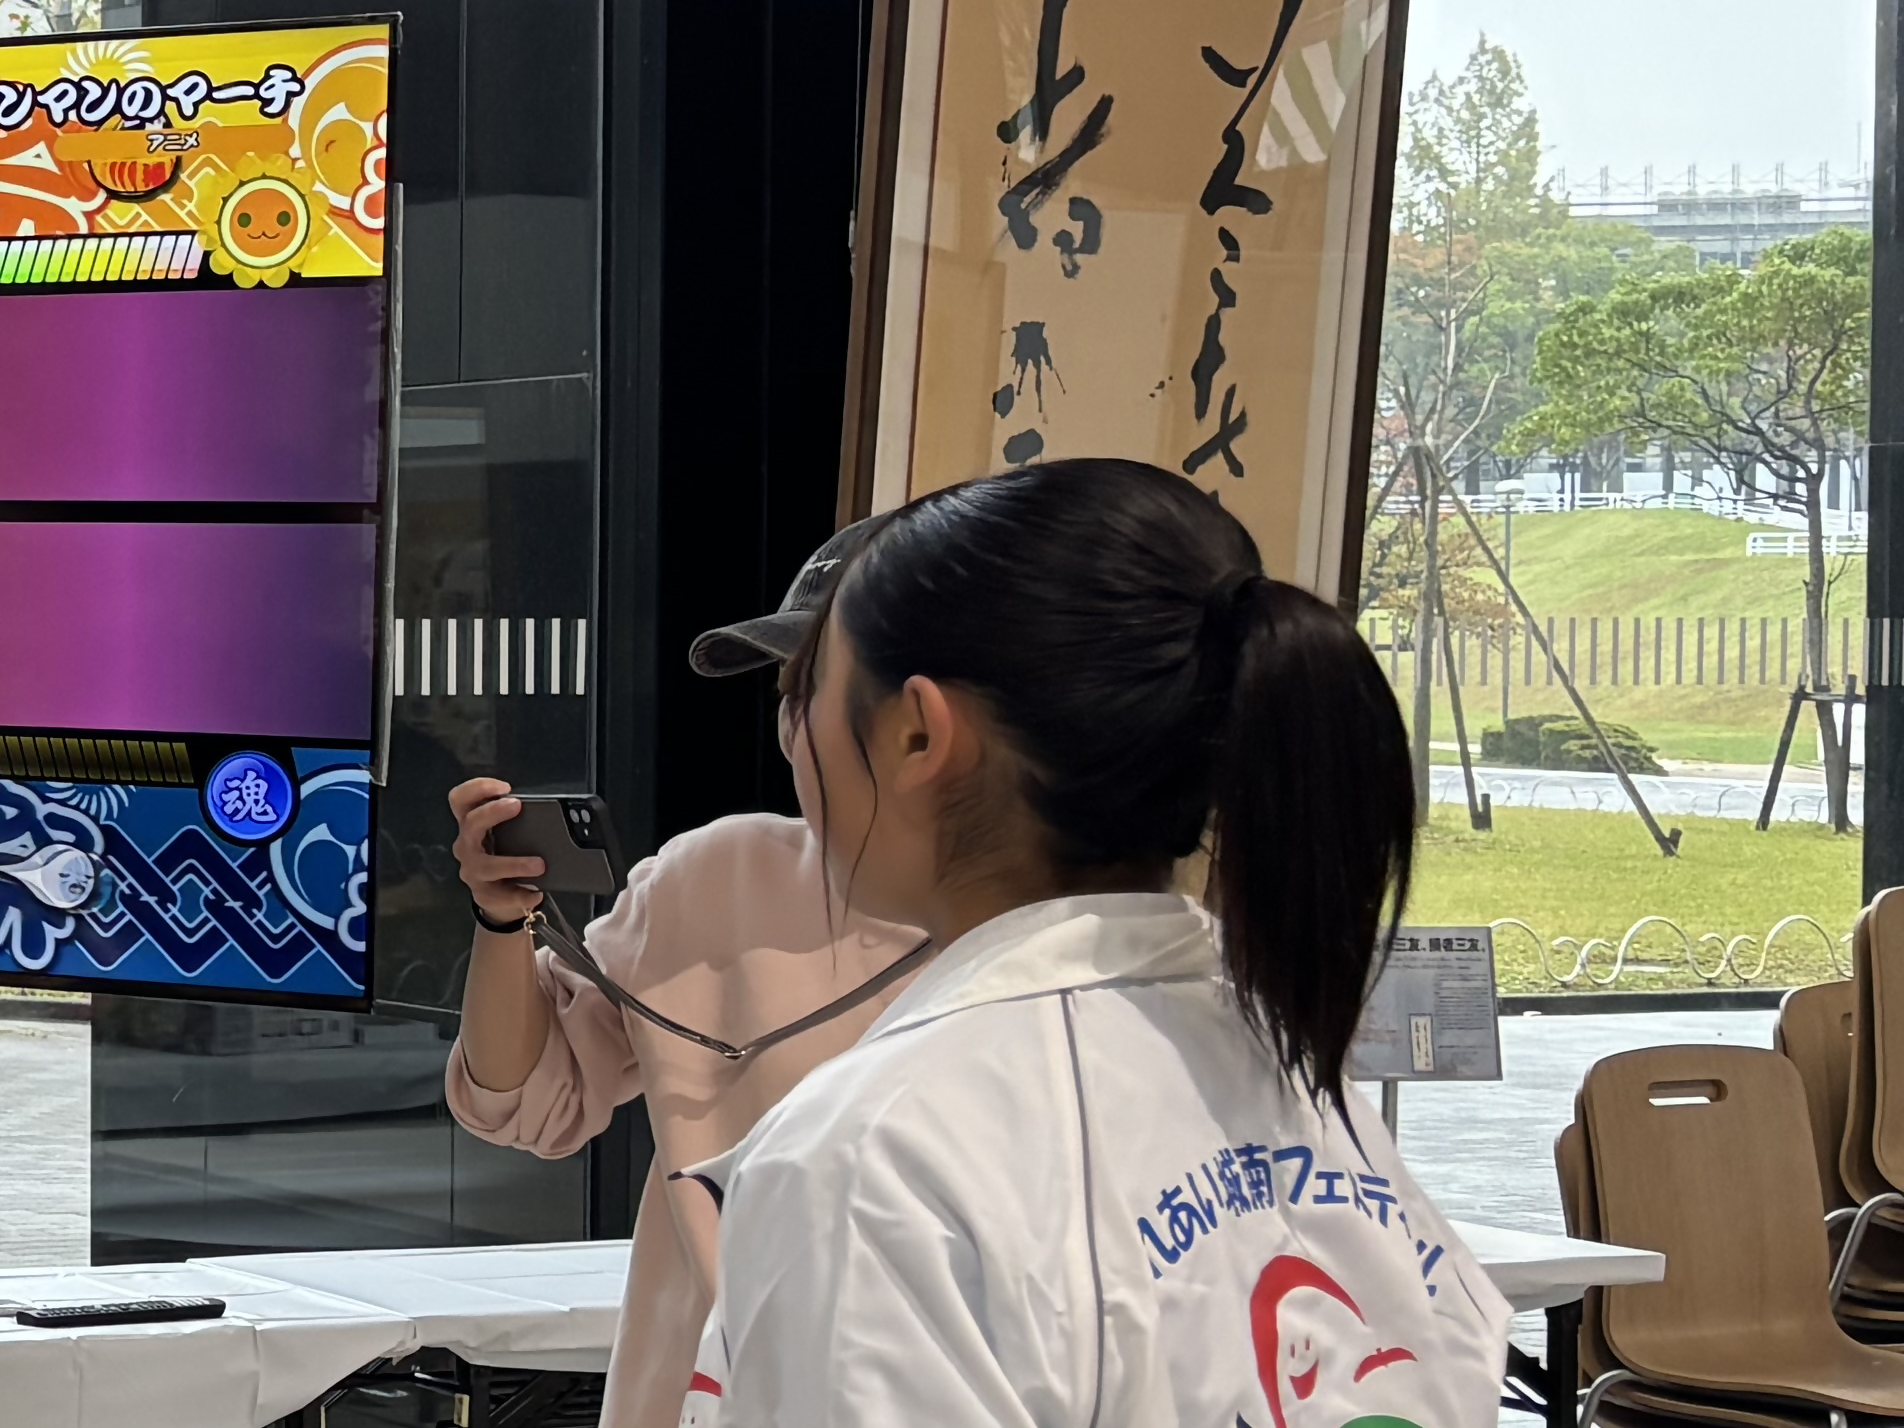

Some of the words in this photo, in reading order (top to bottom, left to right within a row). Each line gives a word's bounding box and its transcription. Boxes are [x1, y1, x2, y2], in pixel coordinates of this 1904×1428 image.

[146, 130, 200, 153] アニメ
[221, 774, 277, 824] 魂
